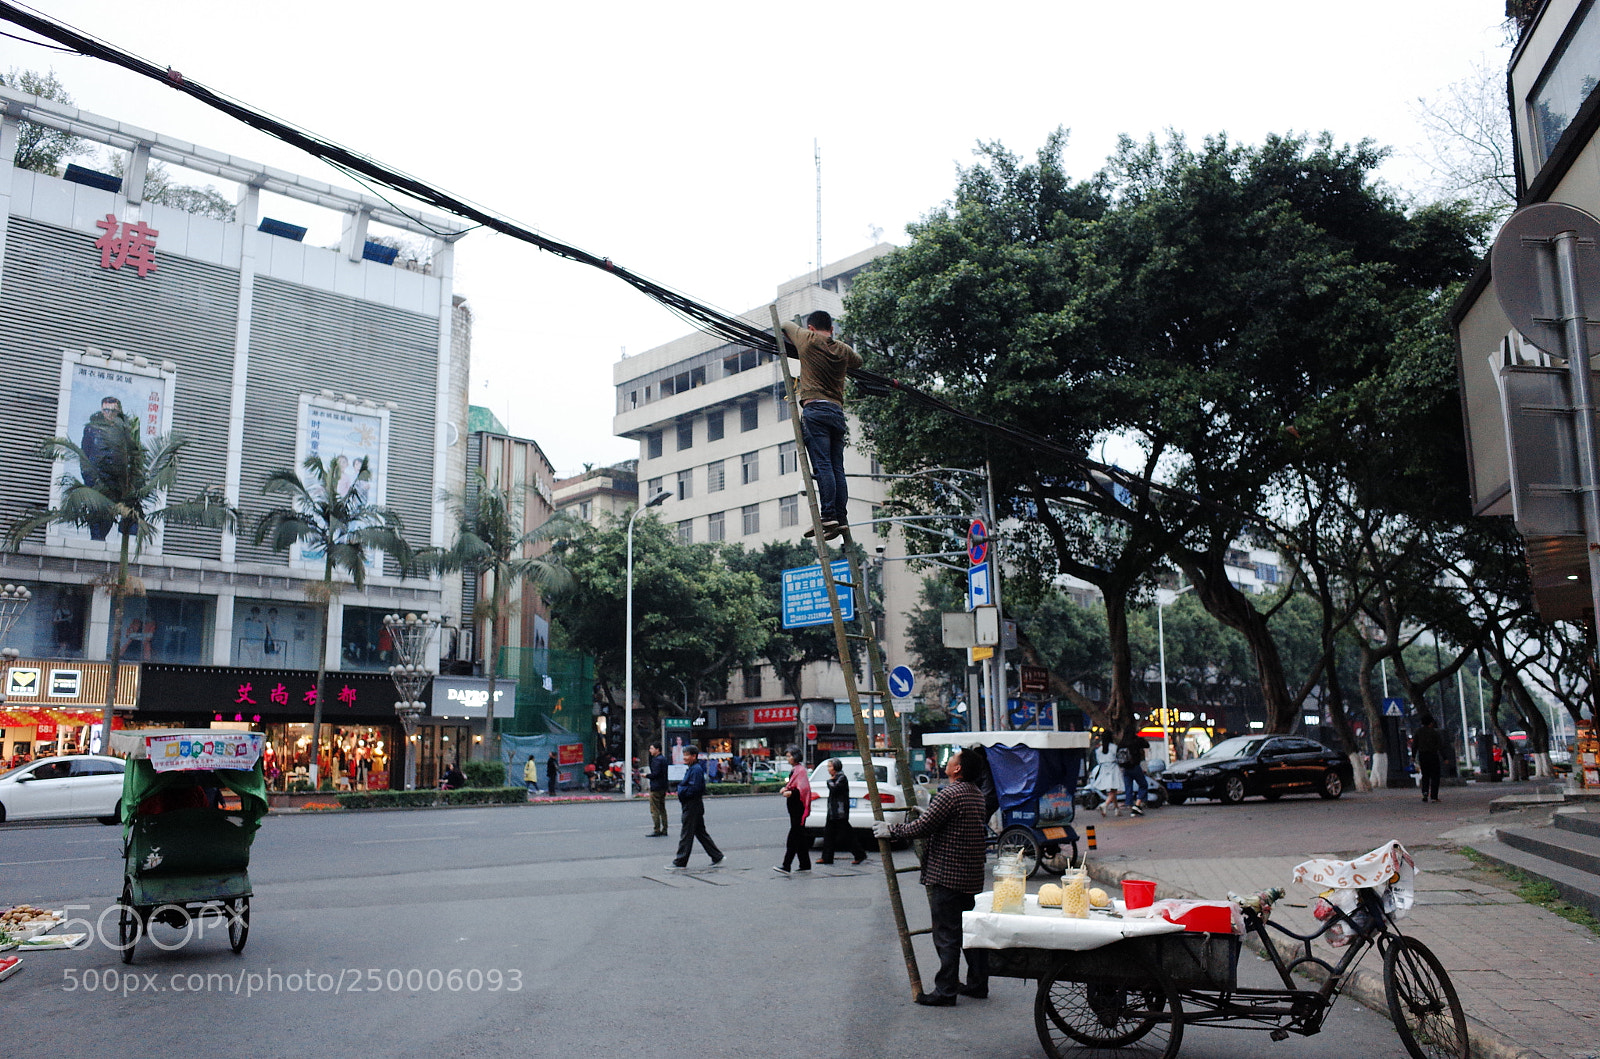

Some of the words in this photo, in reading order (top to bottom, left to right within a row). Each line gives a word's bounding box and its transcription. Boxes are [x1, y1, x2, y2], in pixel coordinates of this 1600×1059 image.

[94, 214, 159, 277] 裤
[147, 391, 160, 436] 品牌男装
[234, 682, 358, 708] 艾尚衣都
